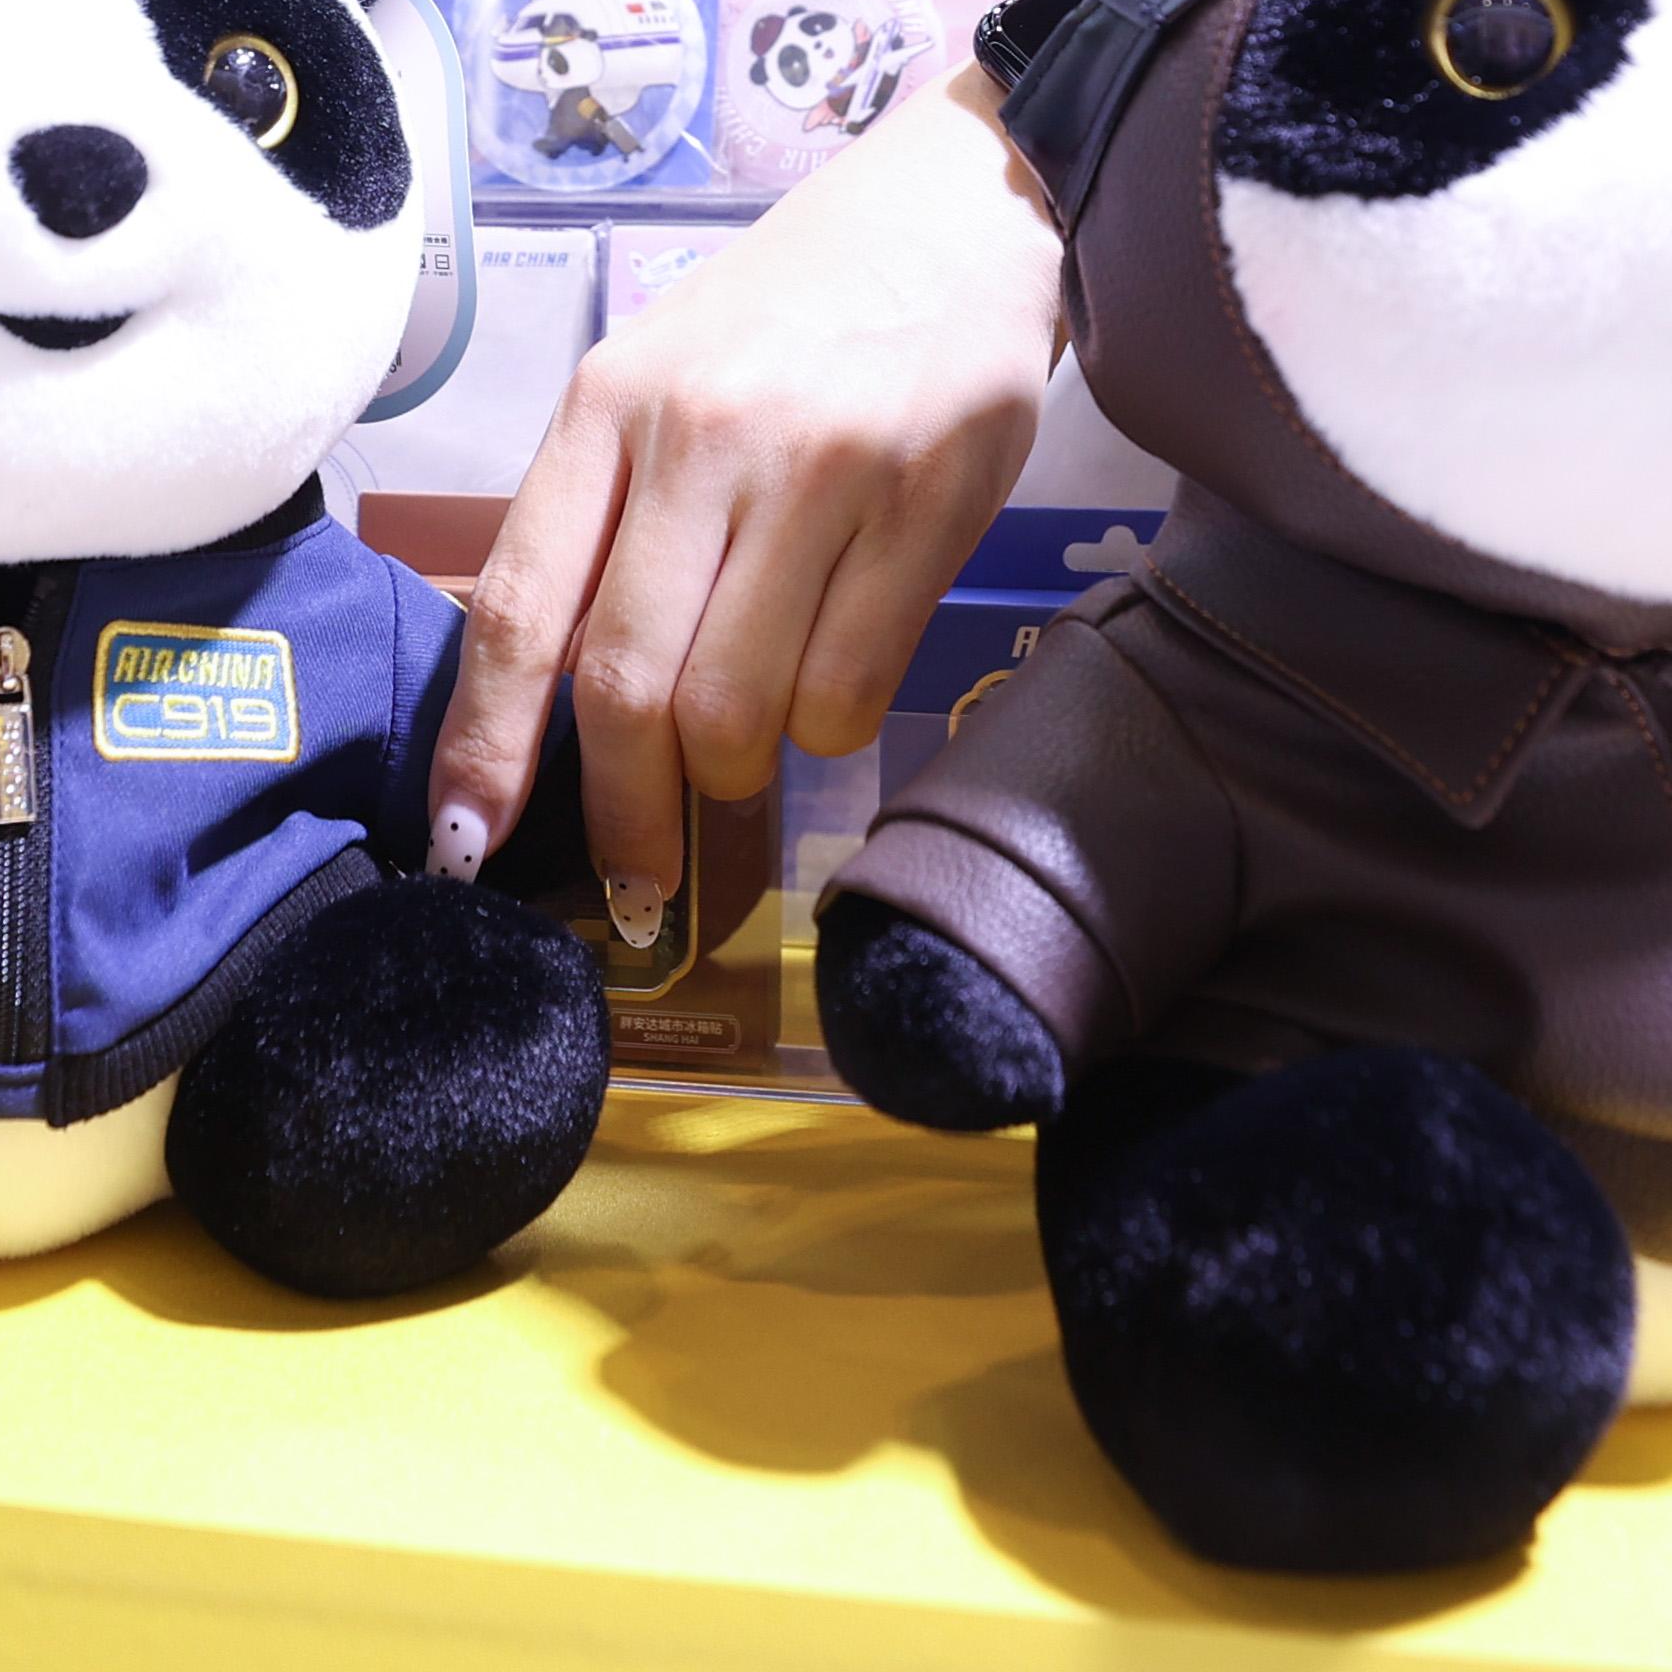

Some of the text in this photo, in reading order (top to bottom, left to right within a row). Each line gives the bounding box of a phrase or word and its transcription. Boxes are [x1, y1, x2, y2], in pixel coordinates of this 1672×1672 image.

[482, 251, 568, 268] AIR CHINA
[113, 645, 278, 690] AIR CHINA
[112, 693, 278, 742] C919
[643, 1032, 700, 1045] SHANG HAI
